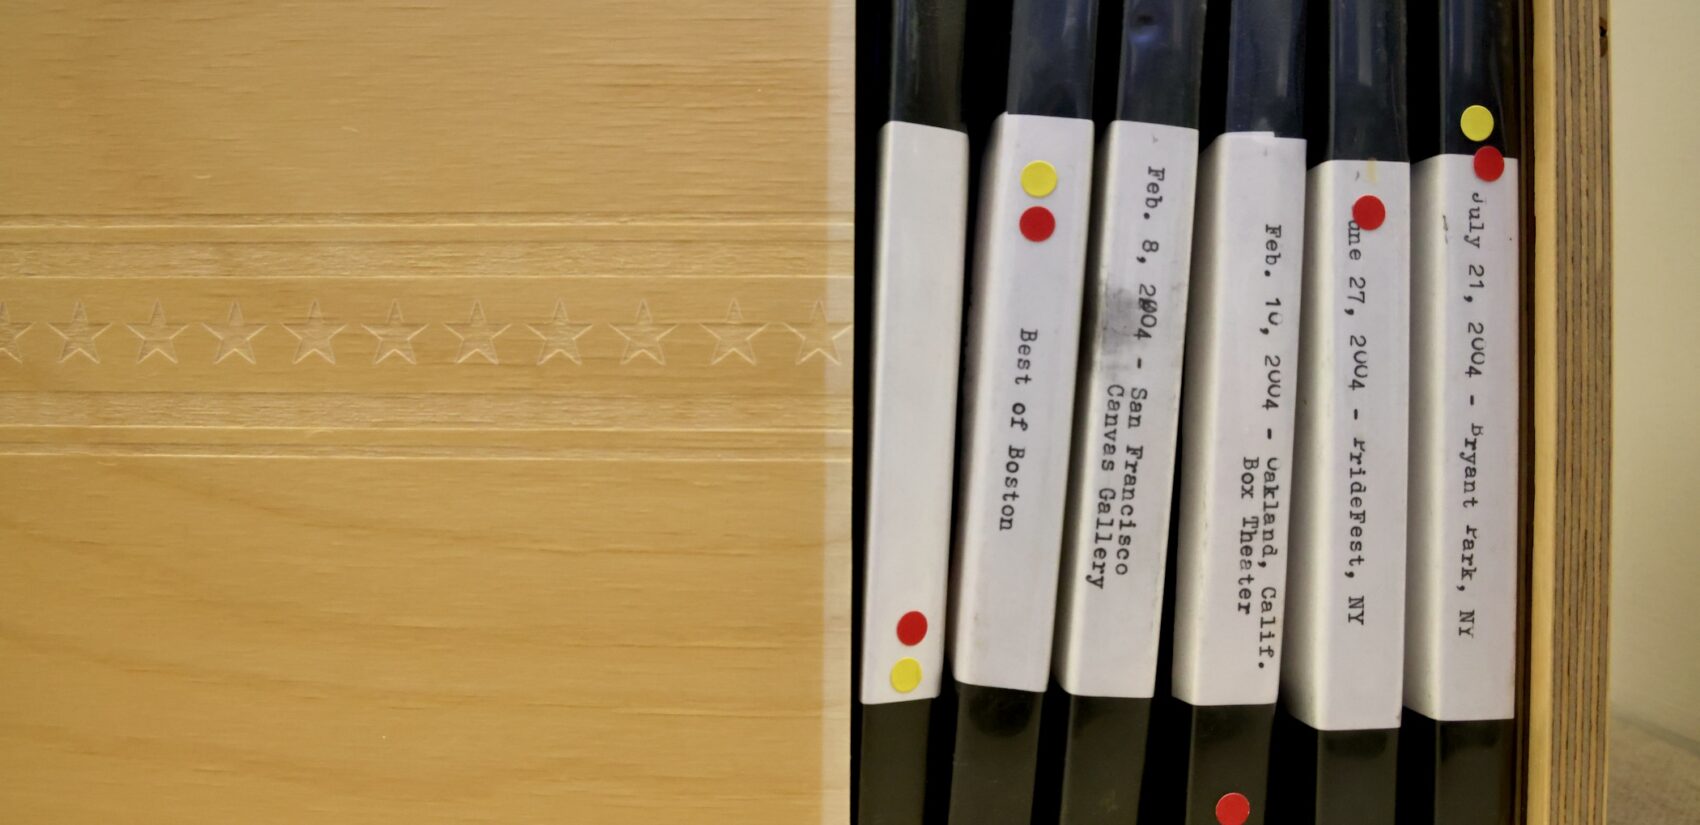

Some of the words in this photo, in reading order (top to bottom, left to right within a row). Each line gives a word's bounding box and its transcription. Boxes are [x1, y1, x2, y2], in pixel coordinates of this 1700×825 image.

[1143, 166, 1165, 219] Feb.
[1464, 192, 1484, 249] July
[1136, 240, 1159, 264] 8,
[1264, 224, 1282, 277] Feb.
[1347, 219, 1363, 261] une
[1344, 276, 1366, 316] 27,
[1463, 264, 1484, 303] 21,
[1133, 284, 1157, 341] 2004
[1259, 298, 1282, 335] 10,
[1015, 328, 1037, 385] Best
[1348, 335, 1368, 391] 2004
[1465, 322, 1485, 378] 2004
[1128, 387, 1147, 429] San
[1262, 355, 1281, 411] 2004
[1011, 402, 1028, 431] of
[1101, 384, 1124, 472] Canvas
[999, 445, 1025, 531] Boston
[1241, 456, 1259, 499] Box
[1460, 423, 1483, 508] Bryant
[1115, 445, 1143, 575] Francisco
[1257, 457, 1280, 568] Oakland,
[1344, 437, 1366, 578] PrideFest,
[1086, 487, 1116, 589] Gallery
[1238, 516, 1259, 615] Theater
[1456, 525, 1478, 592] Park,
[1258, 586, 1277, 669] Calif.
[1347, 595, 1365, 625] NY
[1458, 609, 1475, 637] NY
